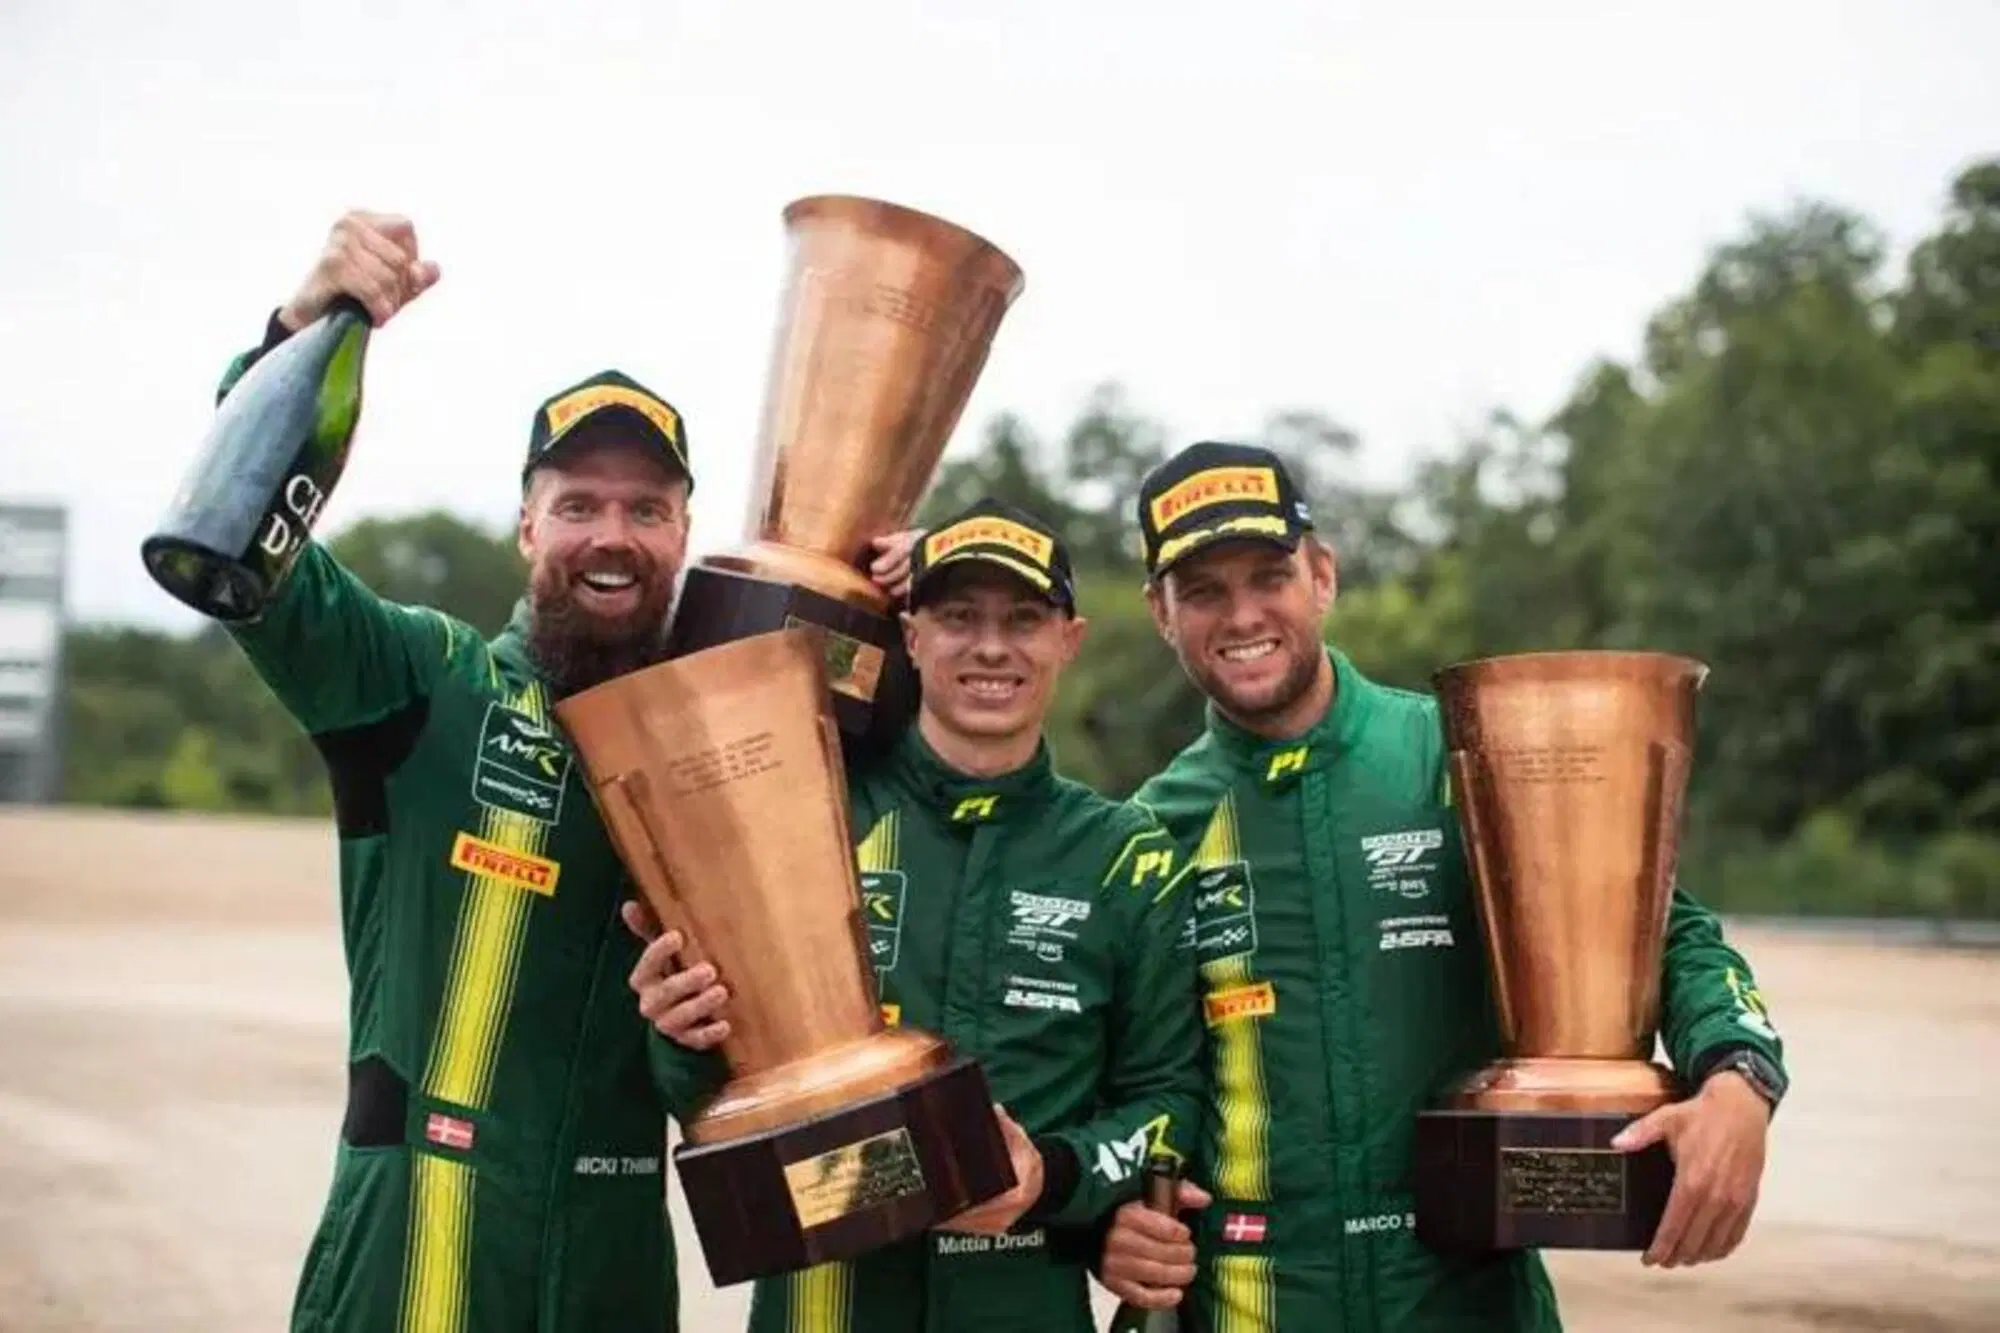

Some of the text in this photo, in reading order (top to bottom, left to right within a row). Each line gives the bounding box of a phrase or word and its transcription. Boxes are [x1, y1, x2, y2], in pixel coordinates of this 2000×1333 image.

[1160, 474, 1266, 521] PIRELLI
[461, 841, 550, 886] PIRELLI
[994, 1228, 1045, 1250] Drudi
[1344, 1214, 1402, 1235] MARCO
